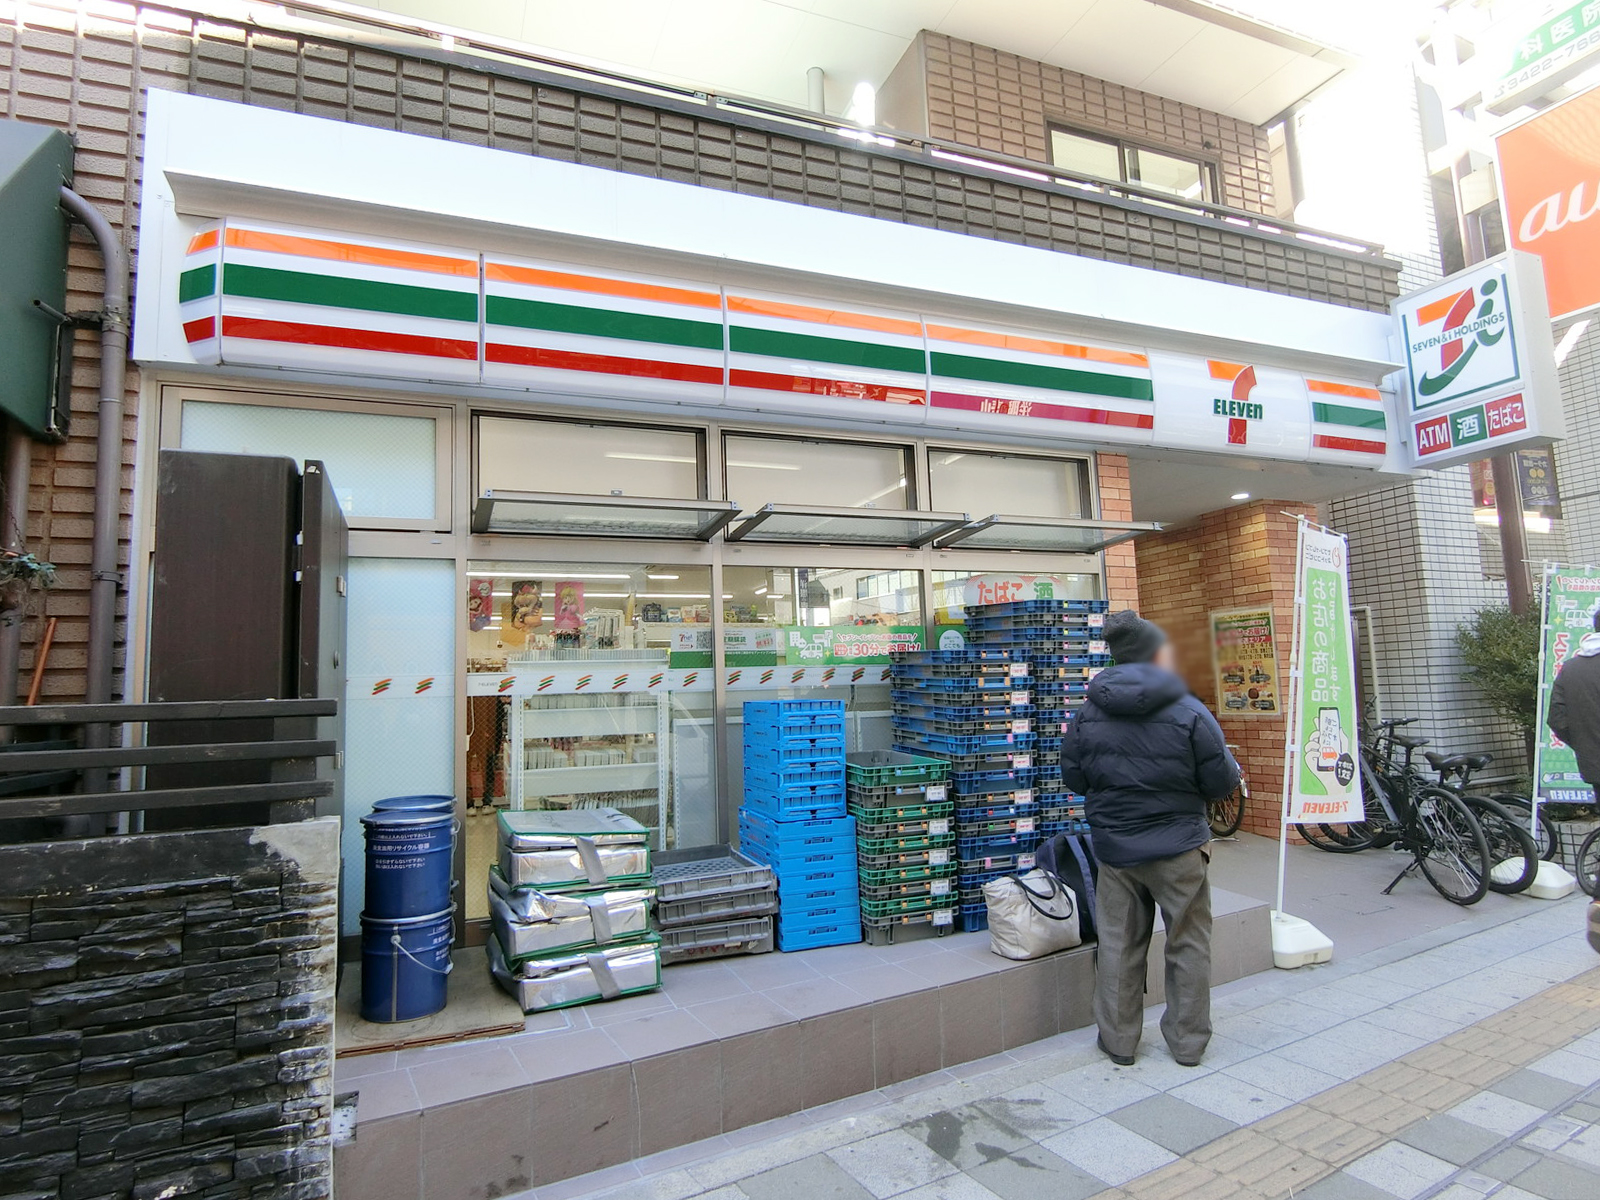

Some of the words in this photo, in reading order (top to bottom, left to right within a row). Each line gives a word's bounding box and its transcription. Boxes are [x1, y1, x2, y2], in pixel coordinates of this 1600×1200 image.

[1453, 312, 1505, 339] HOLDINGS
[1456, 413, 1480, 439] 酒
[1487, 402, 1525, 430] たばこ
[1419, 422, 1449, 449] ATM
[977, 581, 1024, 604] たばこ
[1033, 582, 1054, 600] 酒
